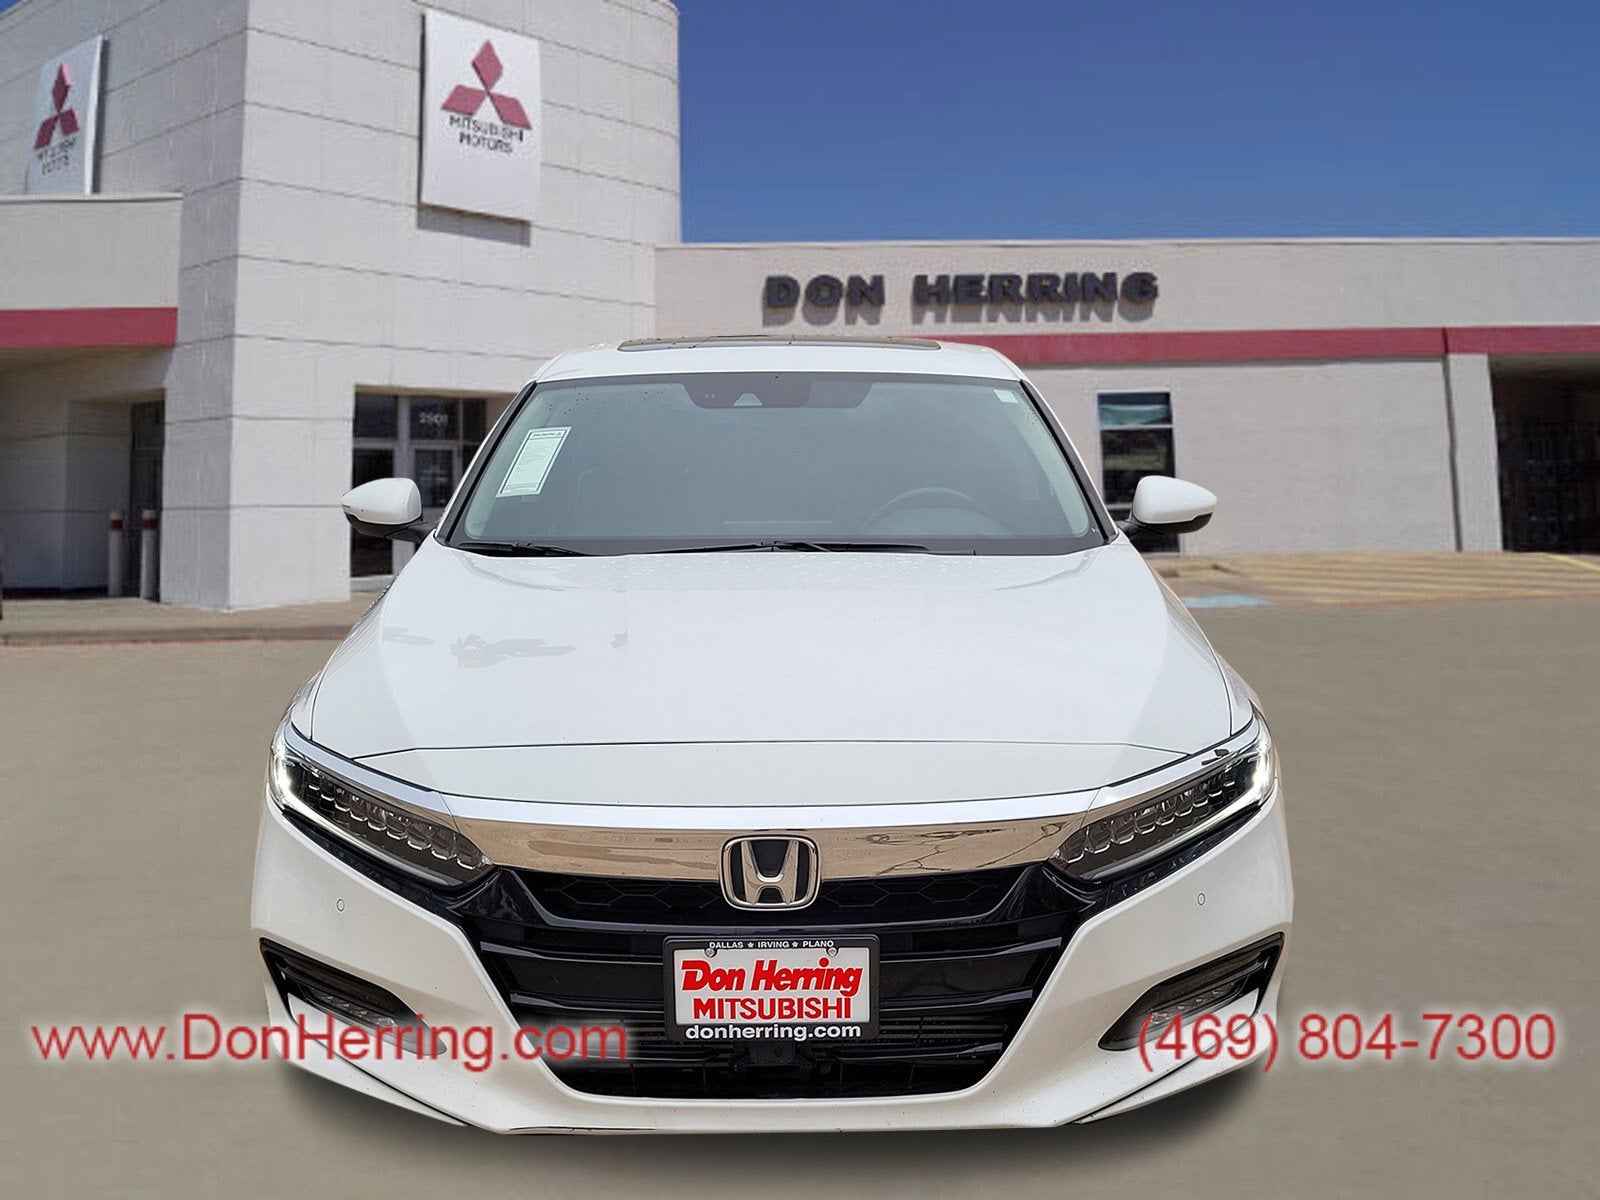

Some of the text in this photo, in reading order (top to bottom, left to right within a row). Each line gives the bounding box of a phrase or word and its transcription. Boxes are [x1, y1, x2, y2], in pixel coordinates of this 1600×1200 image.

[459, 132, 514, 154] MOTORS
[764, 271, 1159, 308] DON HERRING
[709, 940, 834, 949] DALLAS IRVING PLANO
[681, 957, 863, 997] Don Herring
[693, 997, 851, 1020] MITSUBISHI
[685, 1024, 861, 1041] donherring.com
